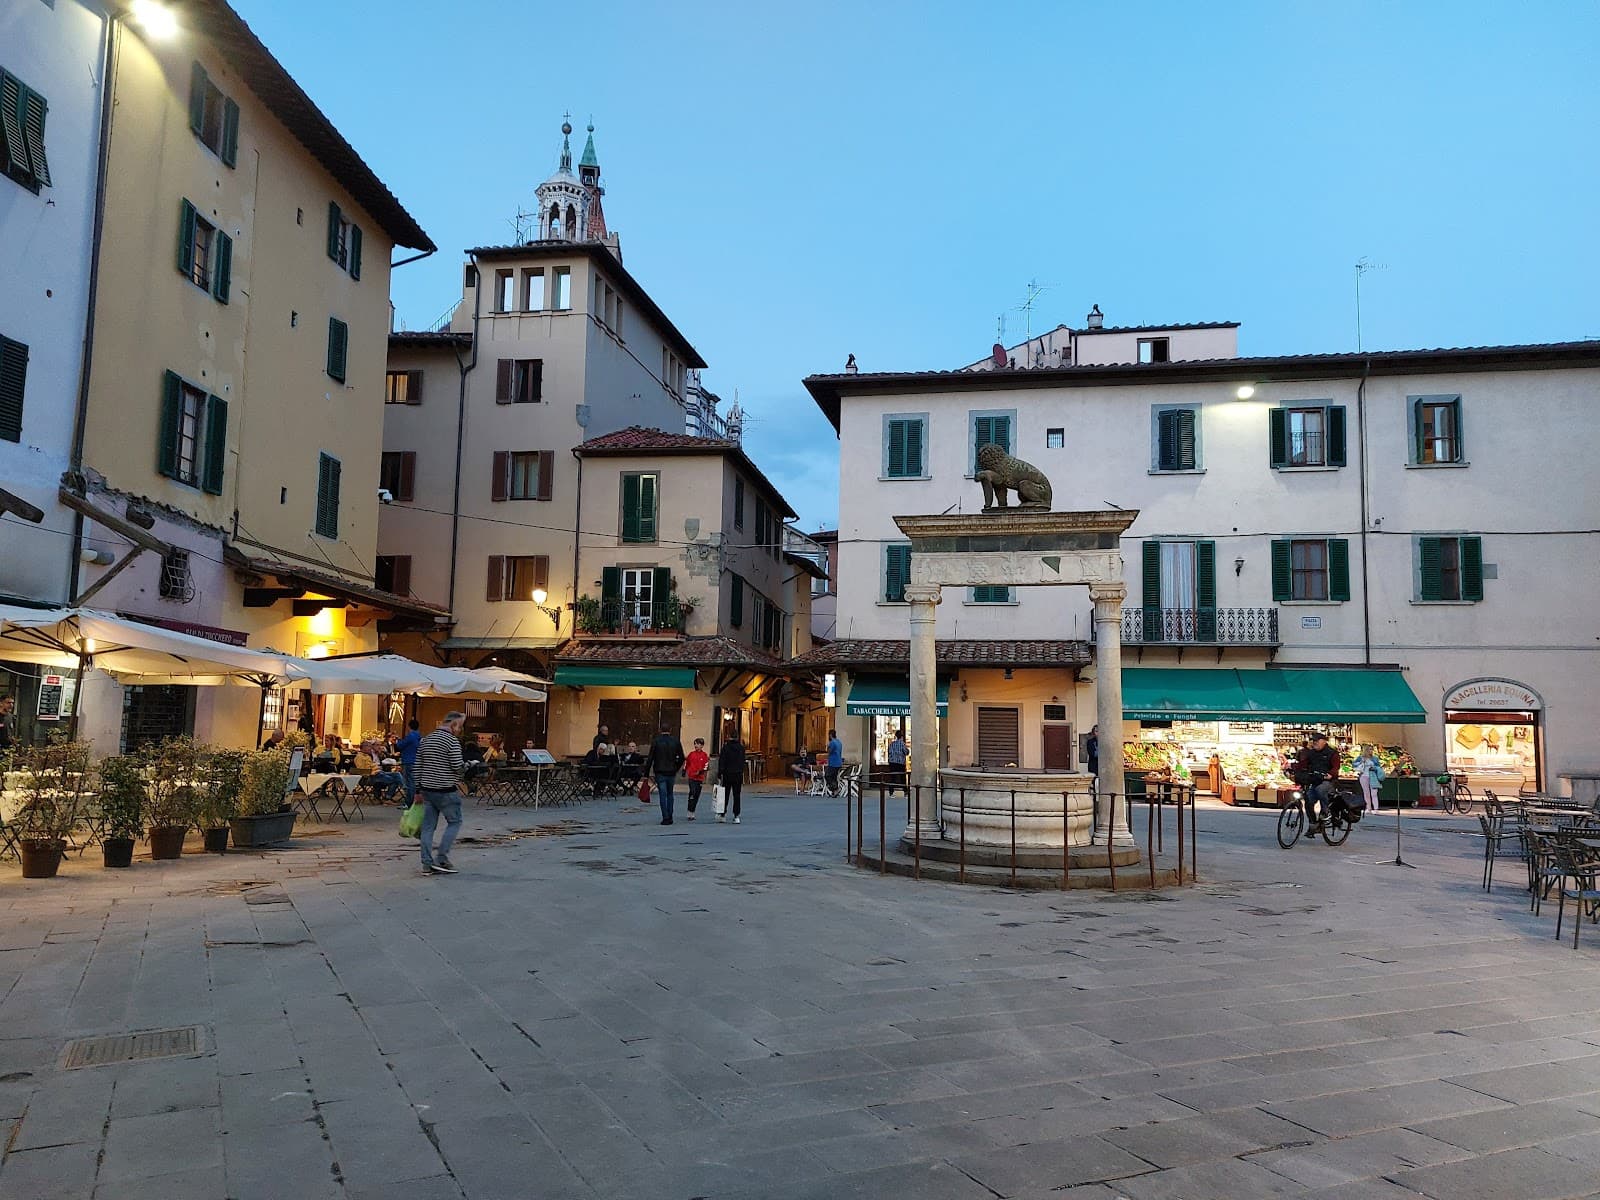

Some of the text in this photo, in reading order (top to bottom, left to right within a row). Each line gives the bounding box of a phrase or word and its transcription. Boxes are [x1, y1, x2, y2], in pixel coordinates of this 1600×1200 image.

[1451, 685, 1536, 707] MACELLERIA EQUINA
[853, 707, 893, 715] TABACCHERIA
